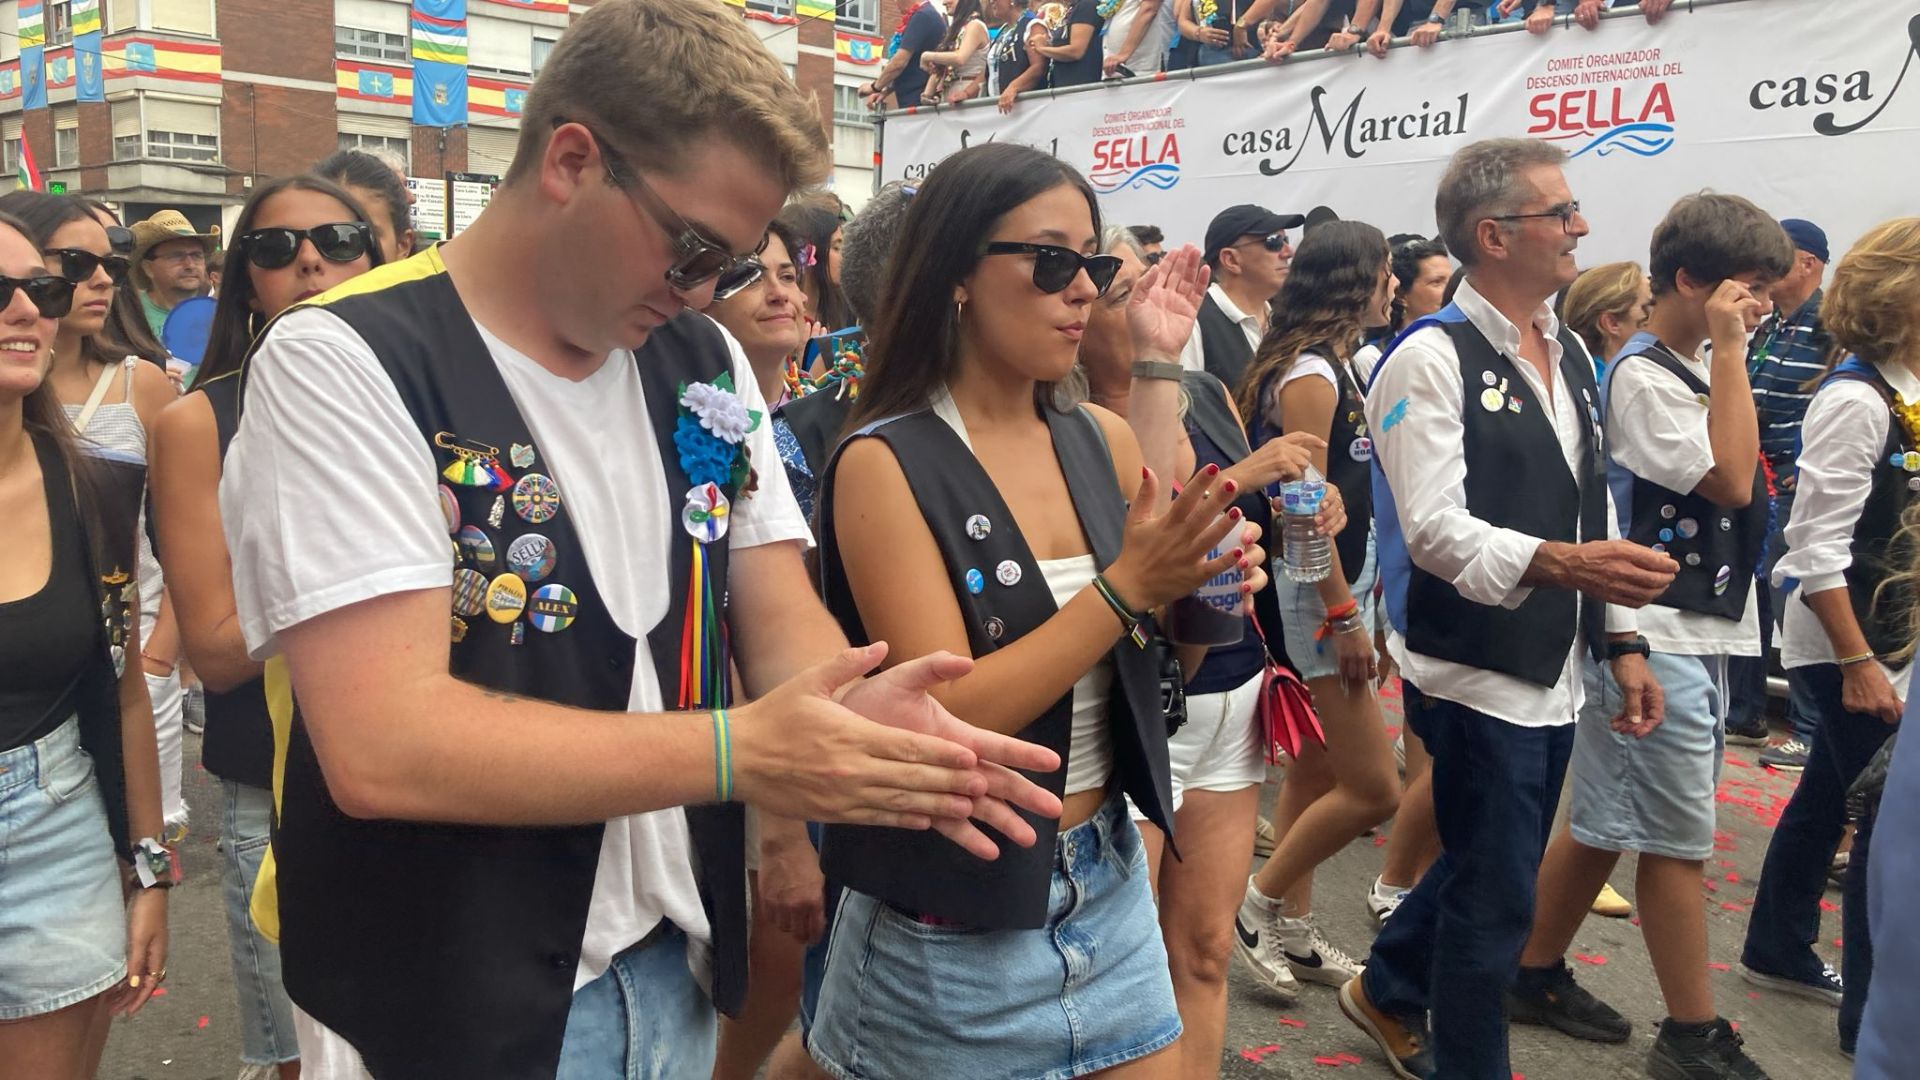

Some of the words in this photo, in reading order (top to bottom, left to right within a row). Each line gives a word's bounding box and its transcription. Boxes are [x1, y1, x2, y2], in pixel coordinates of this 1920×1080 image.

[1547, 54, 1584, 72] COMITÉ
[1586, 48, 1661, 68] ORGANIZADOR
[1526, 73, 1579, 90] DESCENSO
[1581, 64, 1660, 84] INTERNACIONAL
[1663, 62, 1683, 76] DEL
[1749, 70, 1874, 110] casa
[1527, 82, 1675, 134] SELLA
[1092, 125, 1123, 137] DESCENSO
[1173, 118, 1186, 128] DEL
[1223, 127, 1292, 156] casa
[1259, 85, 1469, 176] Marcial
[1092, 133, 1180, 171] SELLA
[512, 539, 546, 566] SELLA
[535, 601, 571, 614] ALEX
